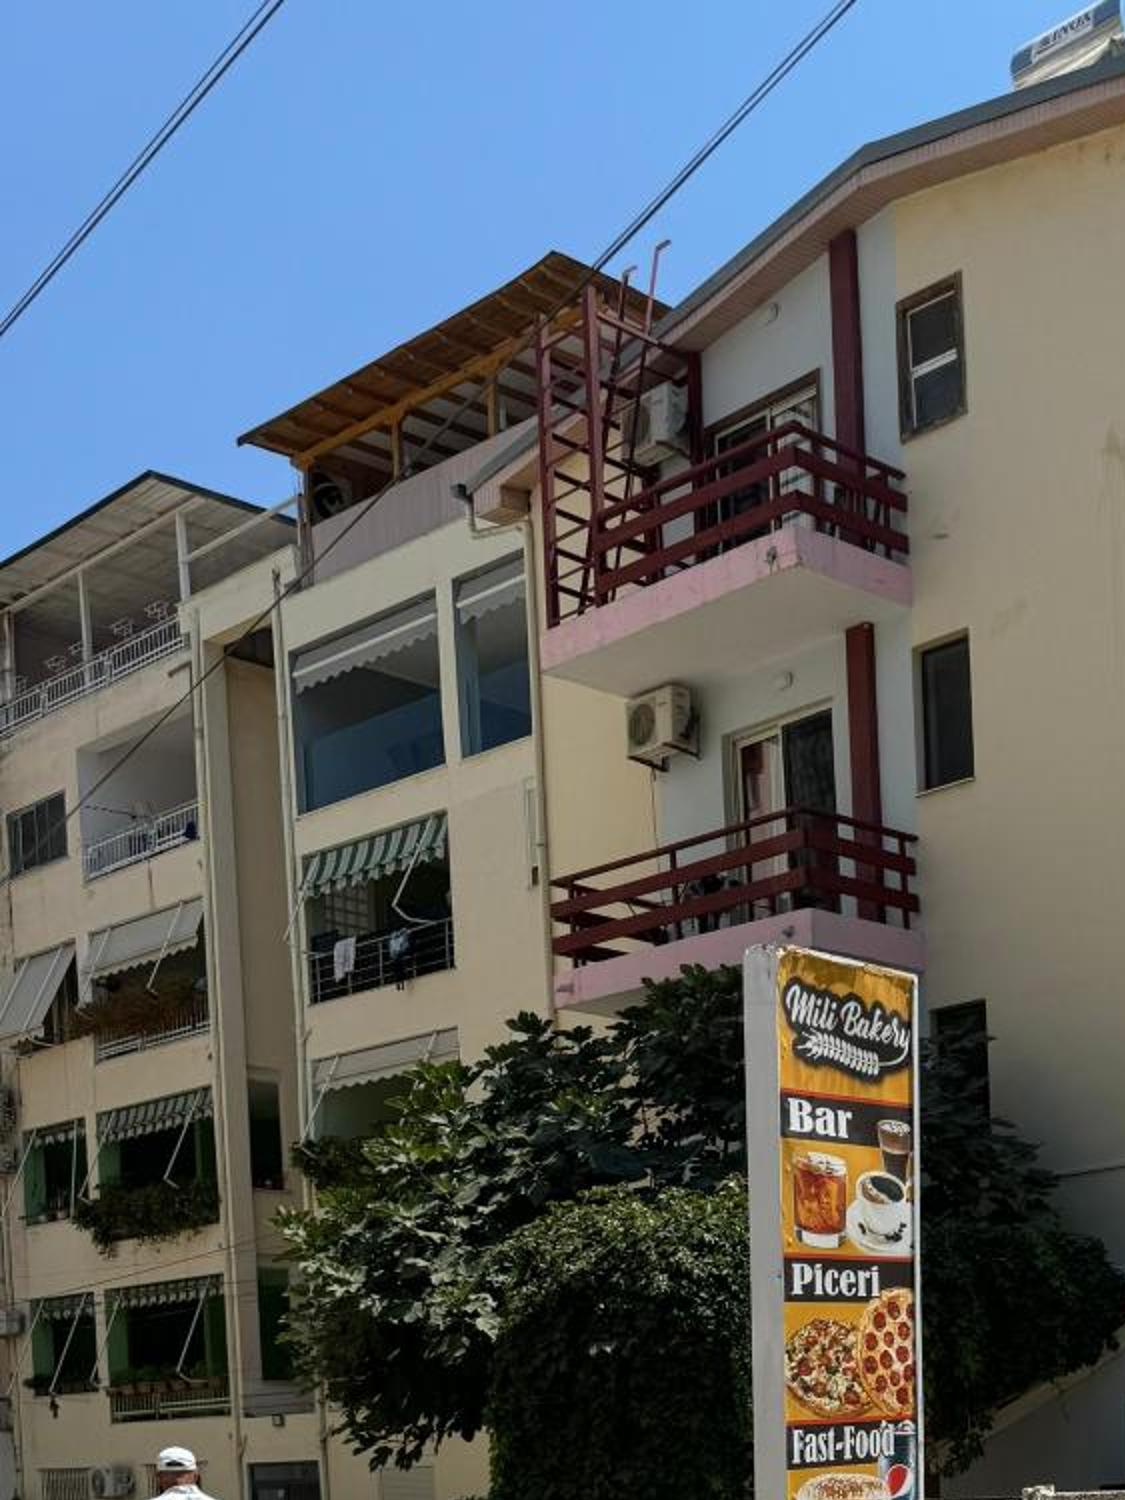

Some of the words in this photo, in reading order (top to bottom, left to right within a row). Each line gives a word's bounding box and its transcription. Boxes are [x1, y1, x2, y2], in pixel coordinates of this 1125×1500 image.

[840, 1000, 910, 1056] Bakery
[787, 1097, 853, 1139] Bar
[791, 1262, 881, 1298] Piceri
[791, 1422, 896, 1464] Fast-Food
